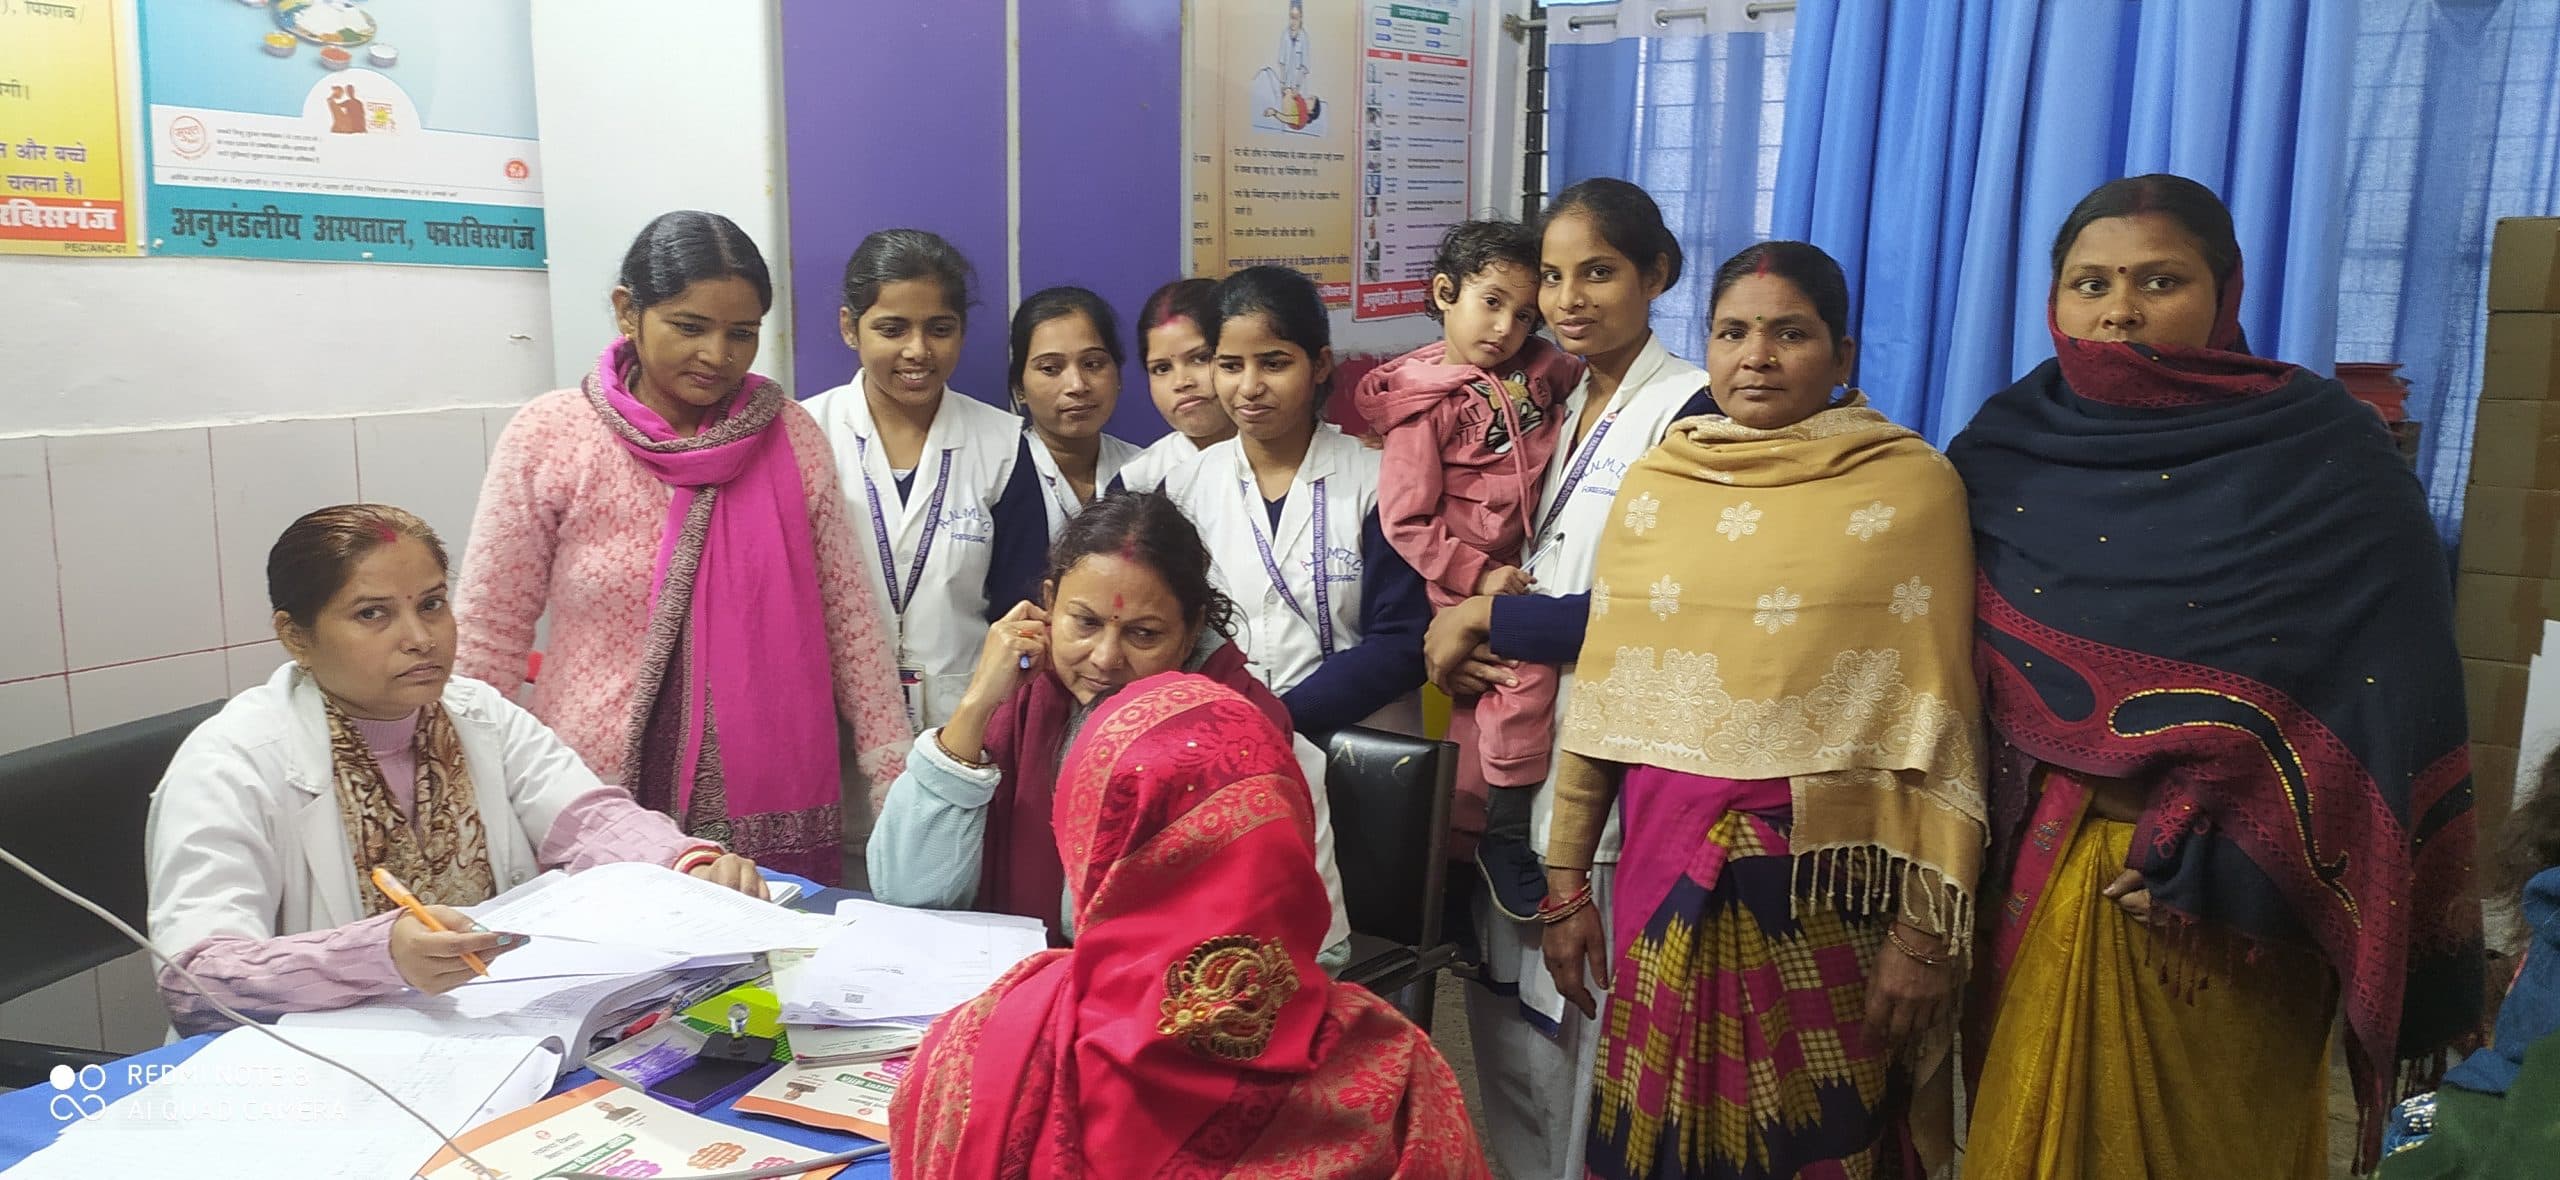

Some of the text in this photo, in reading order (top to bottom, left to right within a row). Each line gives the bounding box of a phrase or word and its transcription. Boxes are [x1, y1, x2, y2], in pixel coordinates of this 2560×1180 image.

[16, 138, 47, 160] और
[54, 142, 86, 162] बच्चे
[7, 175, 58, 192] चलता
[171, 203, 302, 248] अनुमंडलीय
[313, 214, 415, 250] अस्पताल,
[1315, 537, 1323, 561] HOSPITAL
[1319, 602, 1328, 623] SCHOOL
